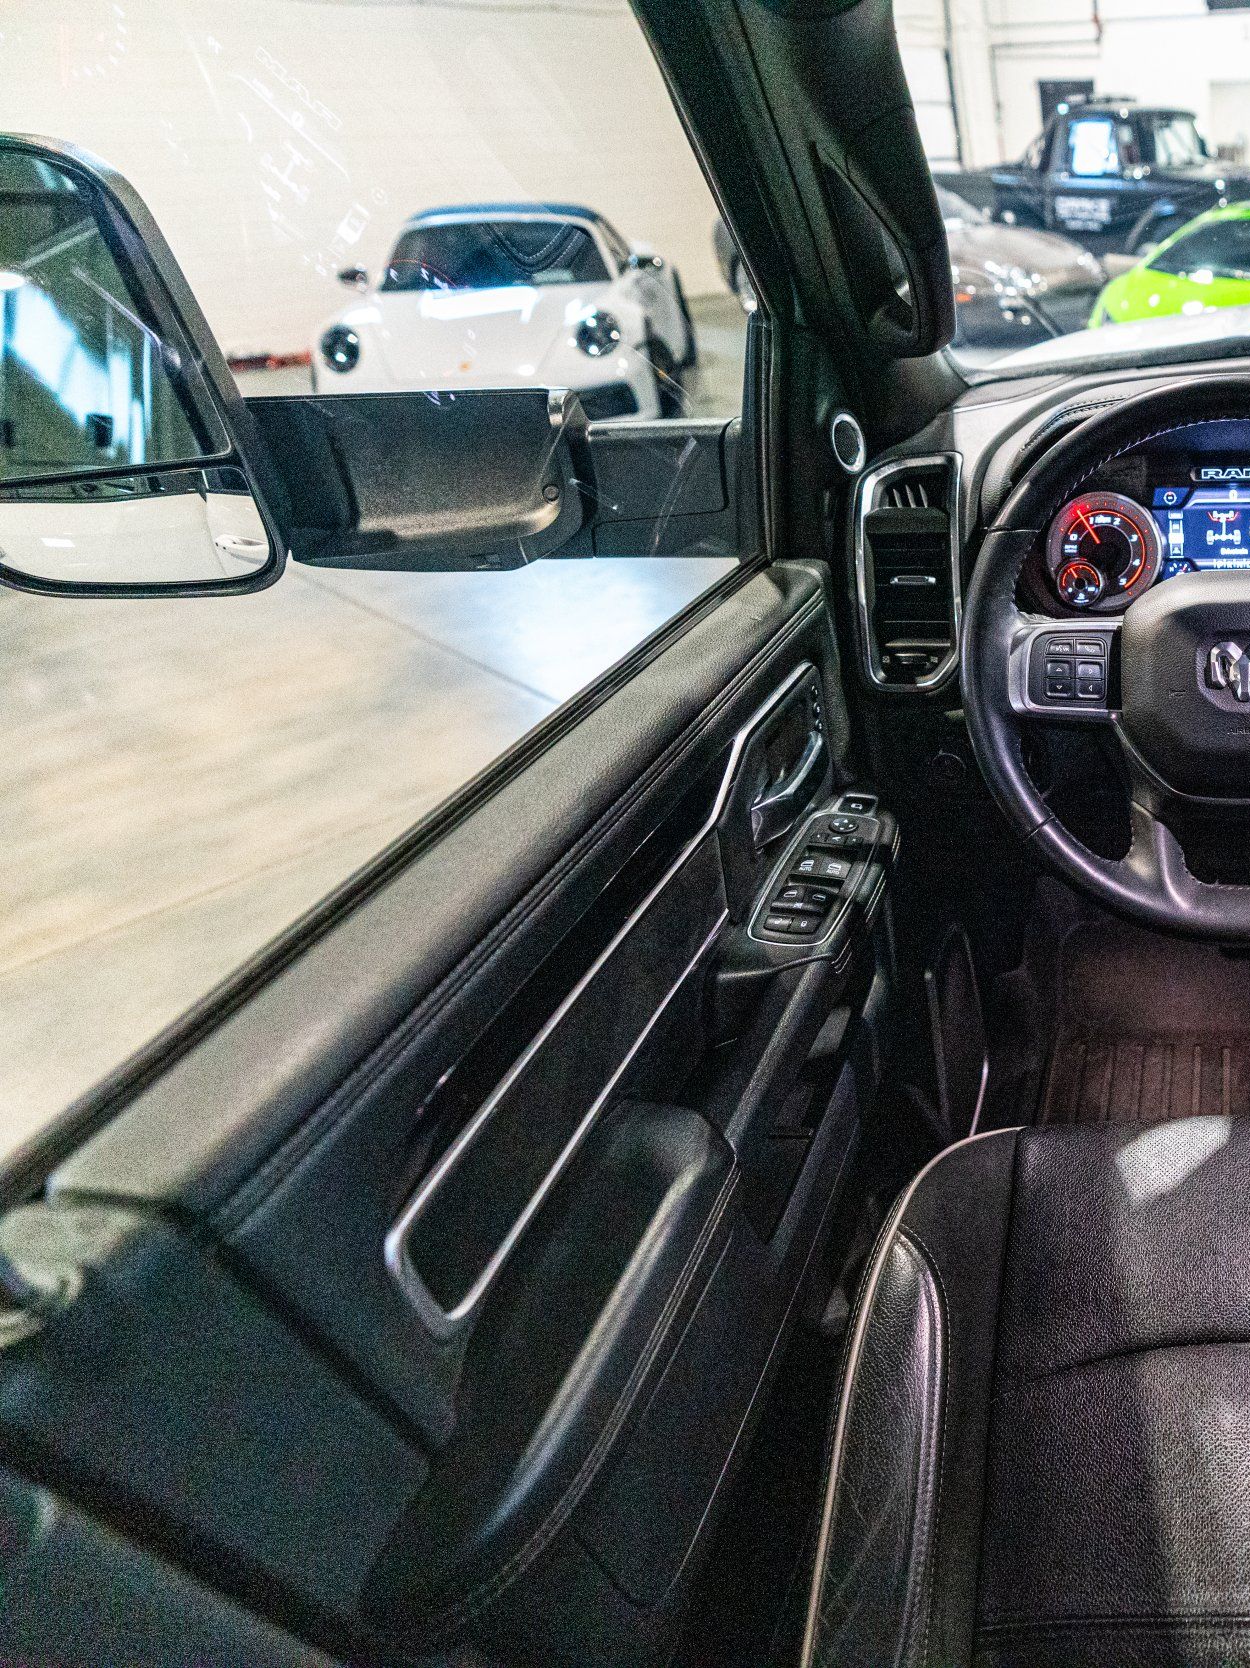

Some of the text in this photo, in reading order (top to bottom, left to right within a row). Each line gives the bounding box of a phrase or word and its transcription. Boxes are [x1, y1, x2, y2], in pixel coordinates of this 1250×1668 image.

[1113, 517, 1121, 525] 2
[1069, 533, 1078, 541] 0
[1130, 534, 1139, 542] 3
